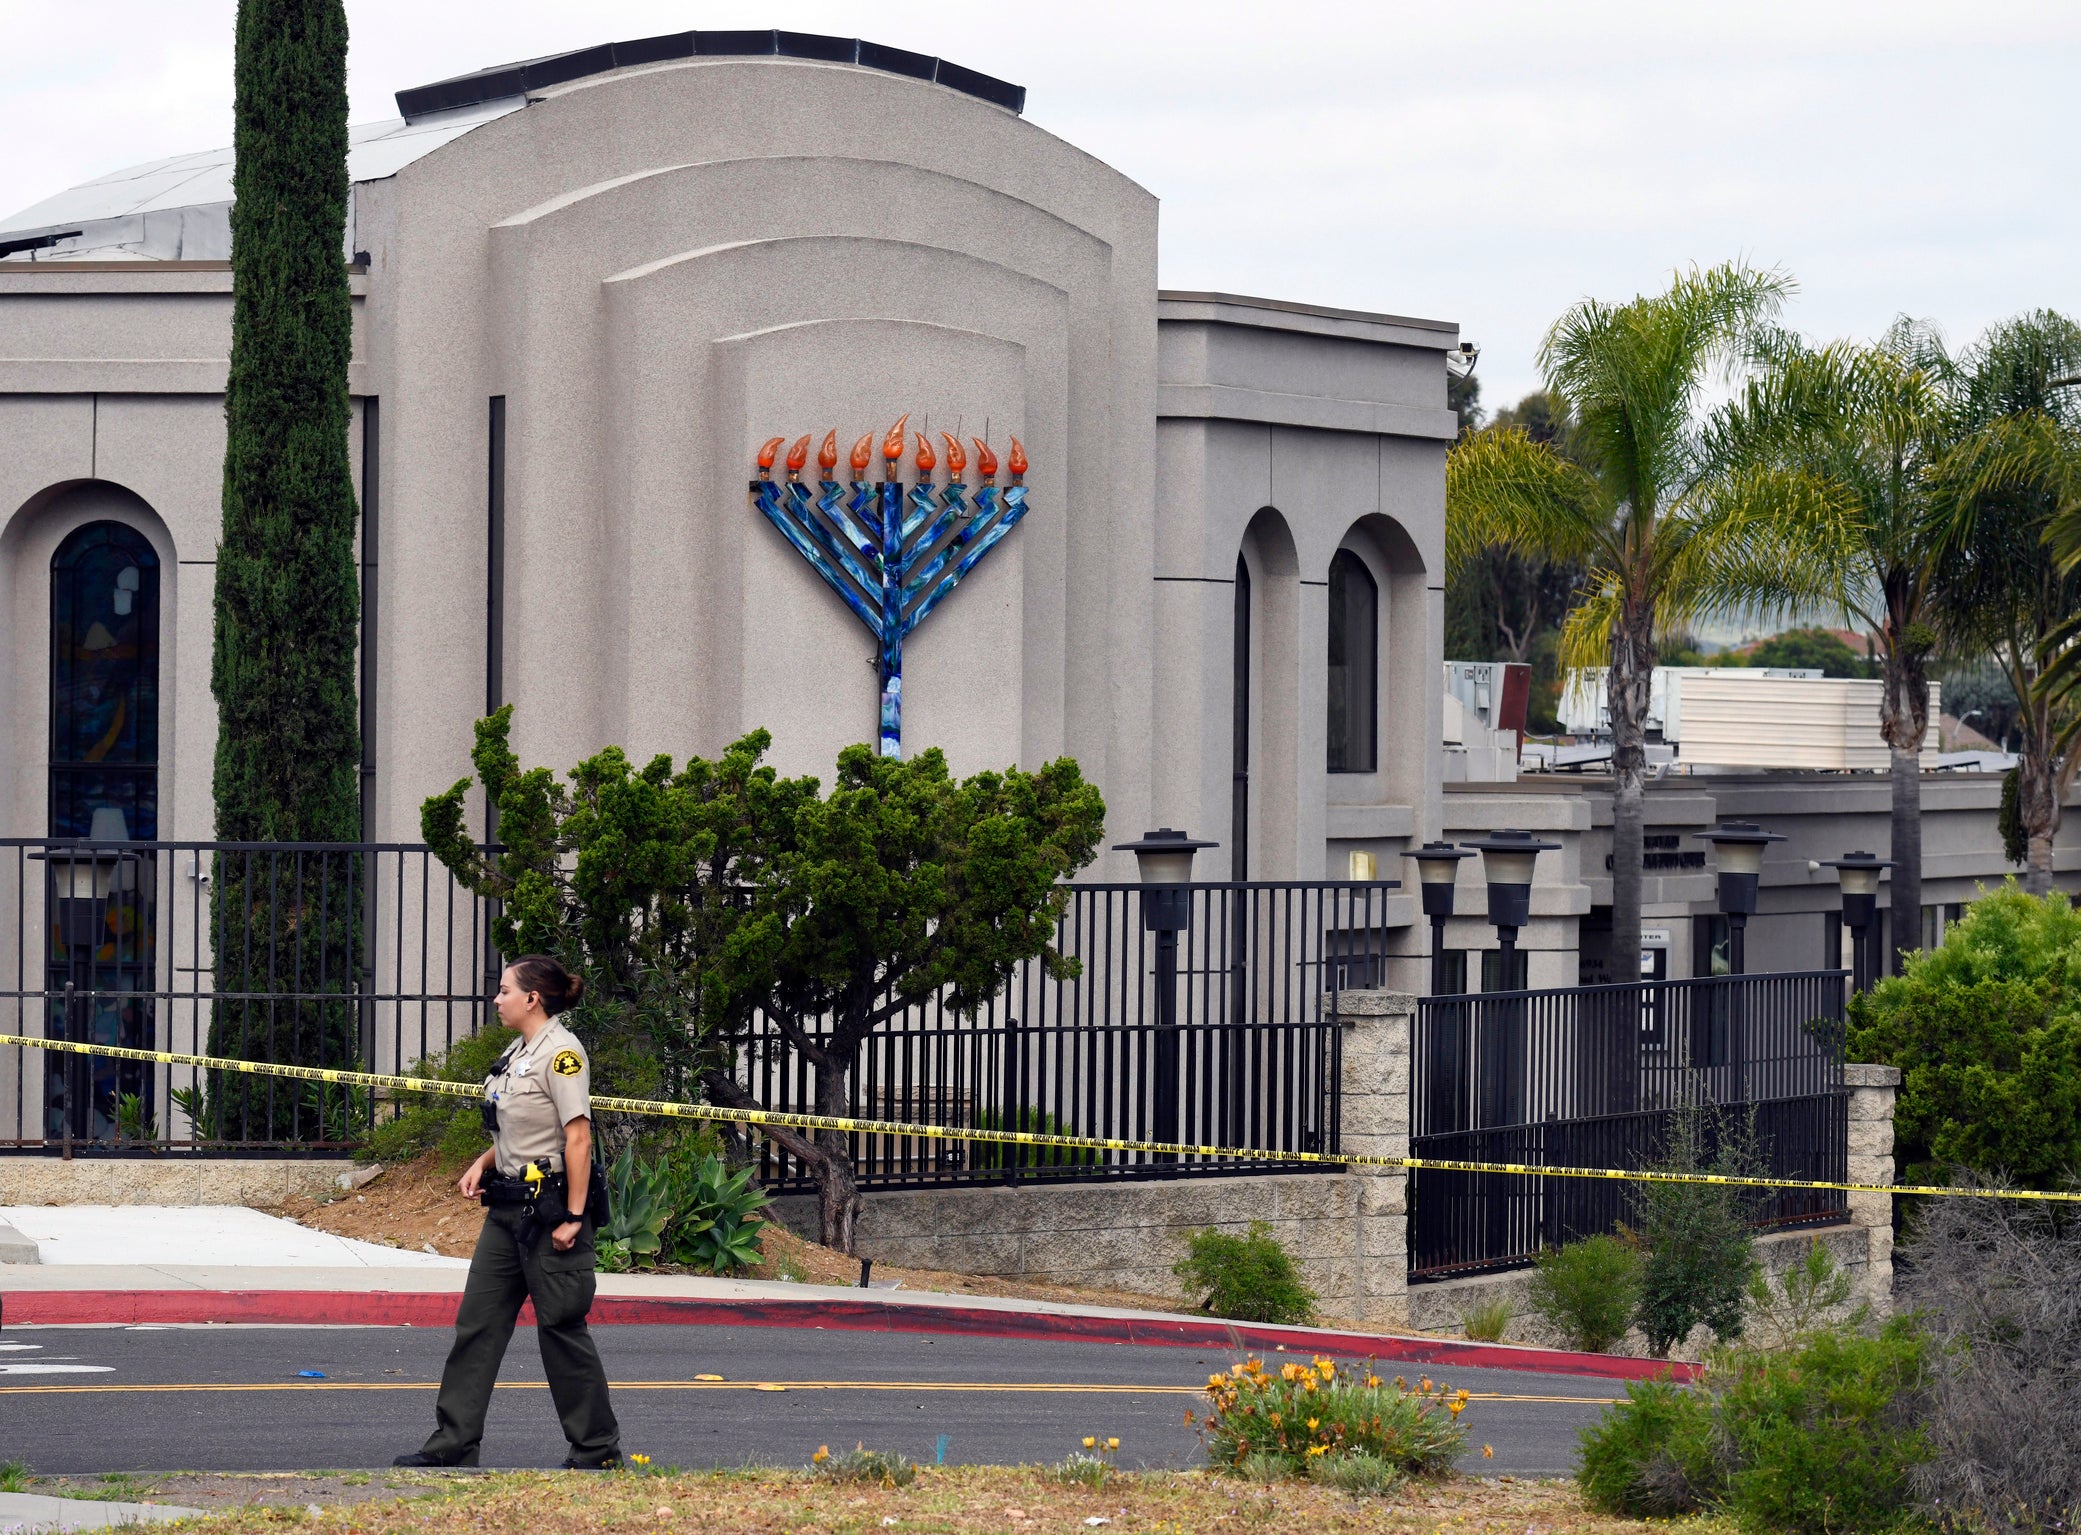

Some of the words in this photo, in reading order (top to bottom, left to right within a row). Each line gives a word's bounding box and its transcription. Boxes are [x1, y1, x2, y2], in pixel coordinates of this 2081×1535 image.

[475, 1085, 485, 1096] CRO
[591, 1096, 612, 1109] SHERIFF
[613, 1099, 624, 1111] LINE
[626, 1100, 633, 1111] DO
[634, 1101, 645, 1113] NOT
[646, 1102, 664, 1114] CROSS
[677, 1104, 698, 1117] SHERIFF
[700, 1106, 711, 1118] LINE
[713, 1107, 720, 1118] DO
[721, 1108, 731, 1119] NOT
[733, 1109, 751, 1121] CROSS
[765, 1112, 786, 1125] SHERIFF
[787, 1114, 799, 1126] LINE
[800, 1115, 808, 1126] DO
[809, 1116, 819, 1127] NOT
[821, 1117, 839, 1129] CROSS
